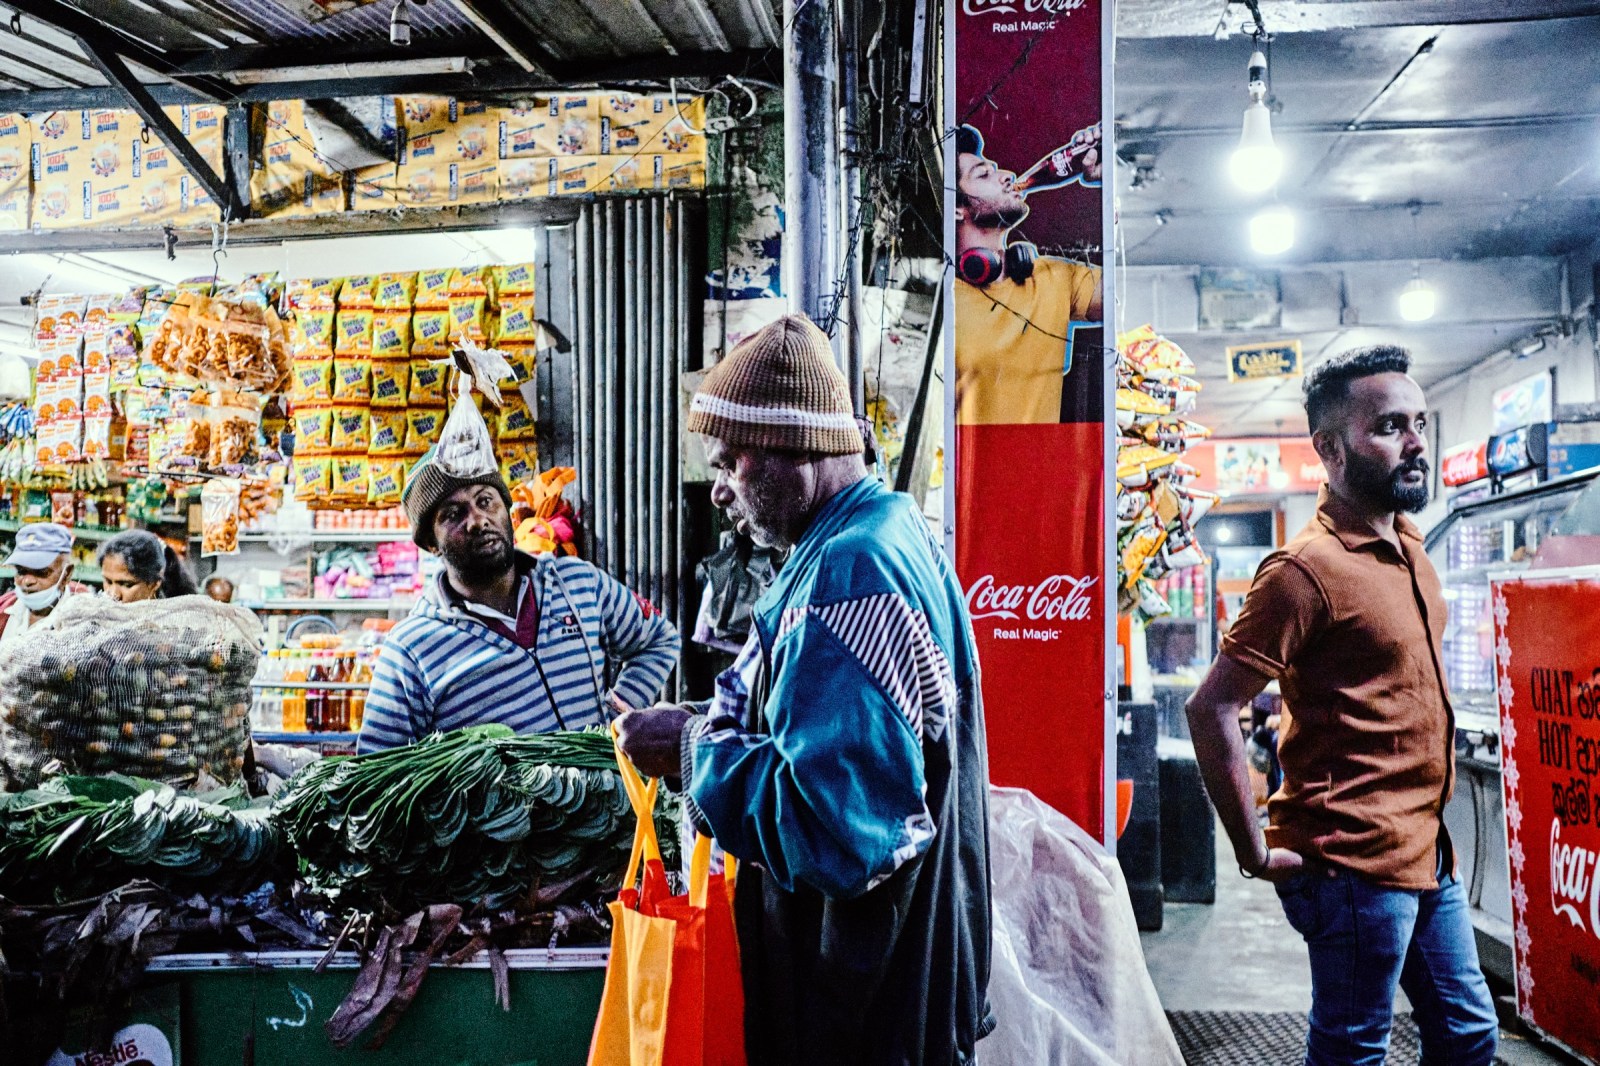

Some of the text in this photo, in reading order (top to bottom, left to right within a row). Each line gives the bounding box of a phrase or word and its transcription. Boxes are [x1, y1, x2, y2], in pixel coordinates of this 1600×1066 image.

[992, 20, 1057, 33] Real Magic
[964, 574, 1100, 620] Coca-Cola
[993, 628, 1059, 642] Real Magic
[1530, 666, 1574, 717] CHAT
[1537, 719, 1572, 771] HOT
